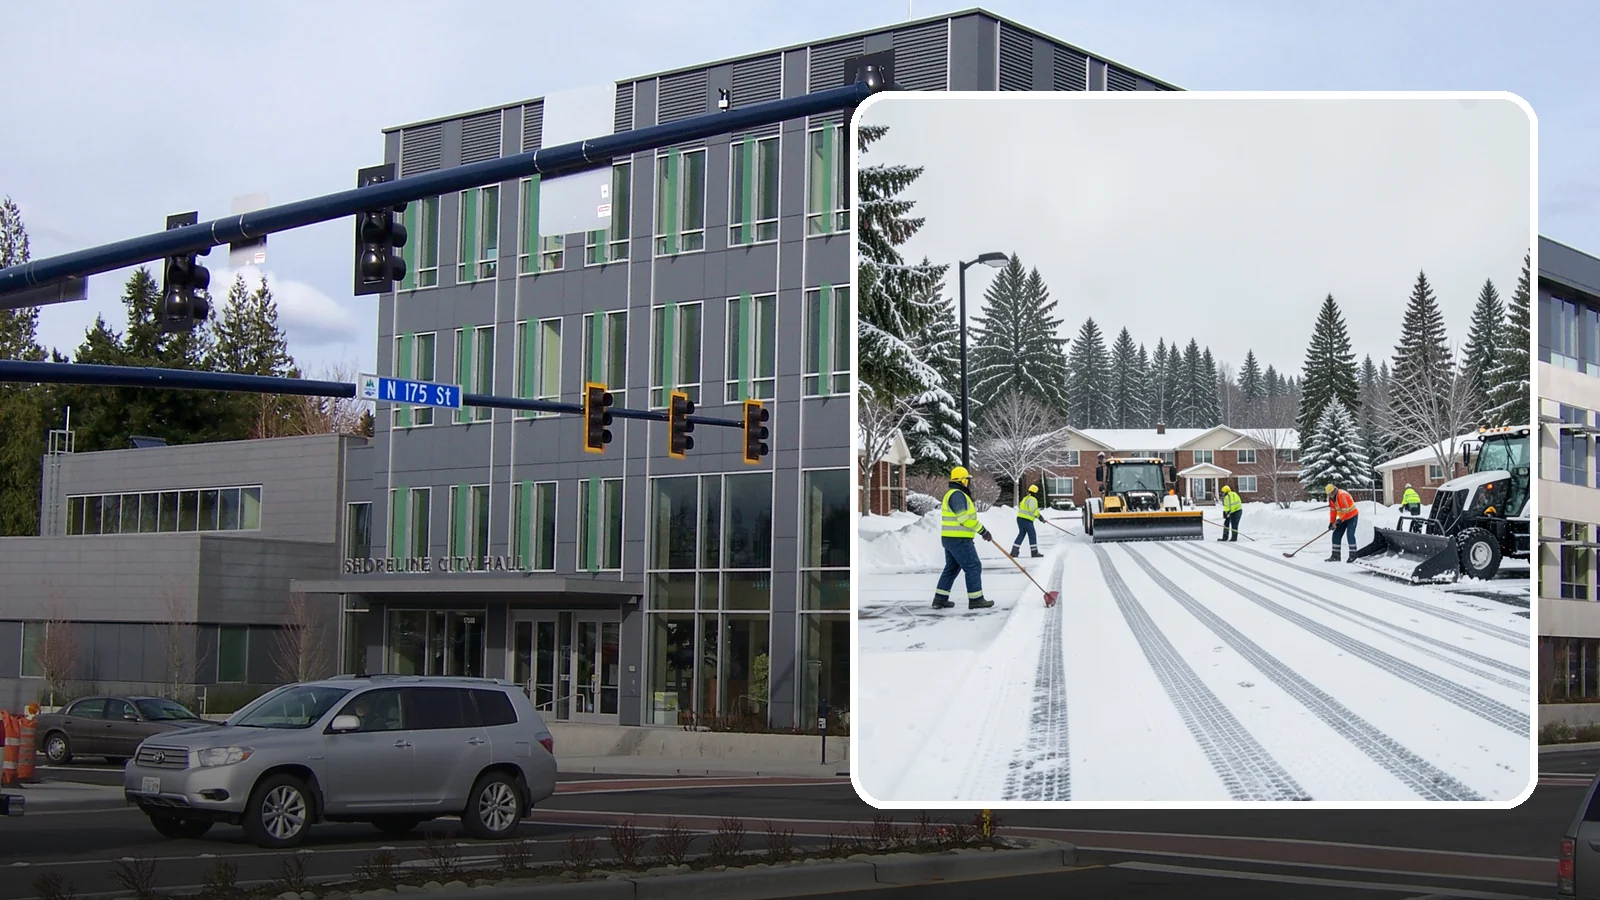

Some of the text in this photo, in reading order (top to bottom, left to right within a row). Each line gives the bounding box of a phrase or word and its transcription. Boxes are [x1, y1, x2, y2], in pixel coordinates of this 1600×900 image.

[387, 380, 452, 406] N 175 St
[344, 555, 526, 574] SHORELINE CITY HALL
